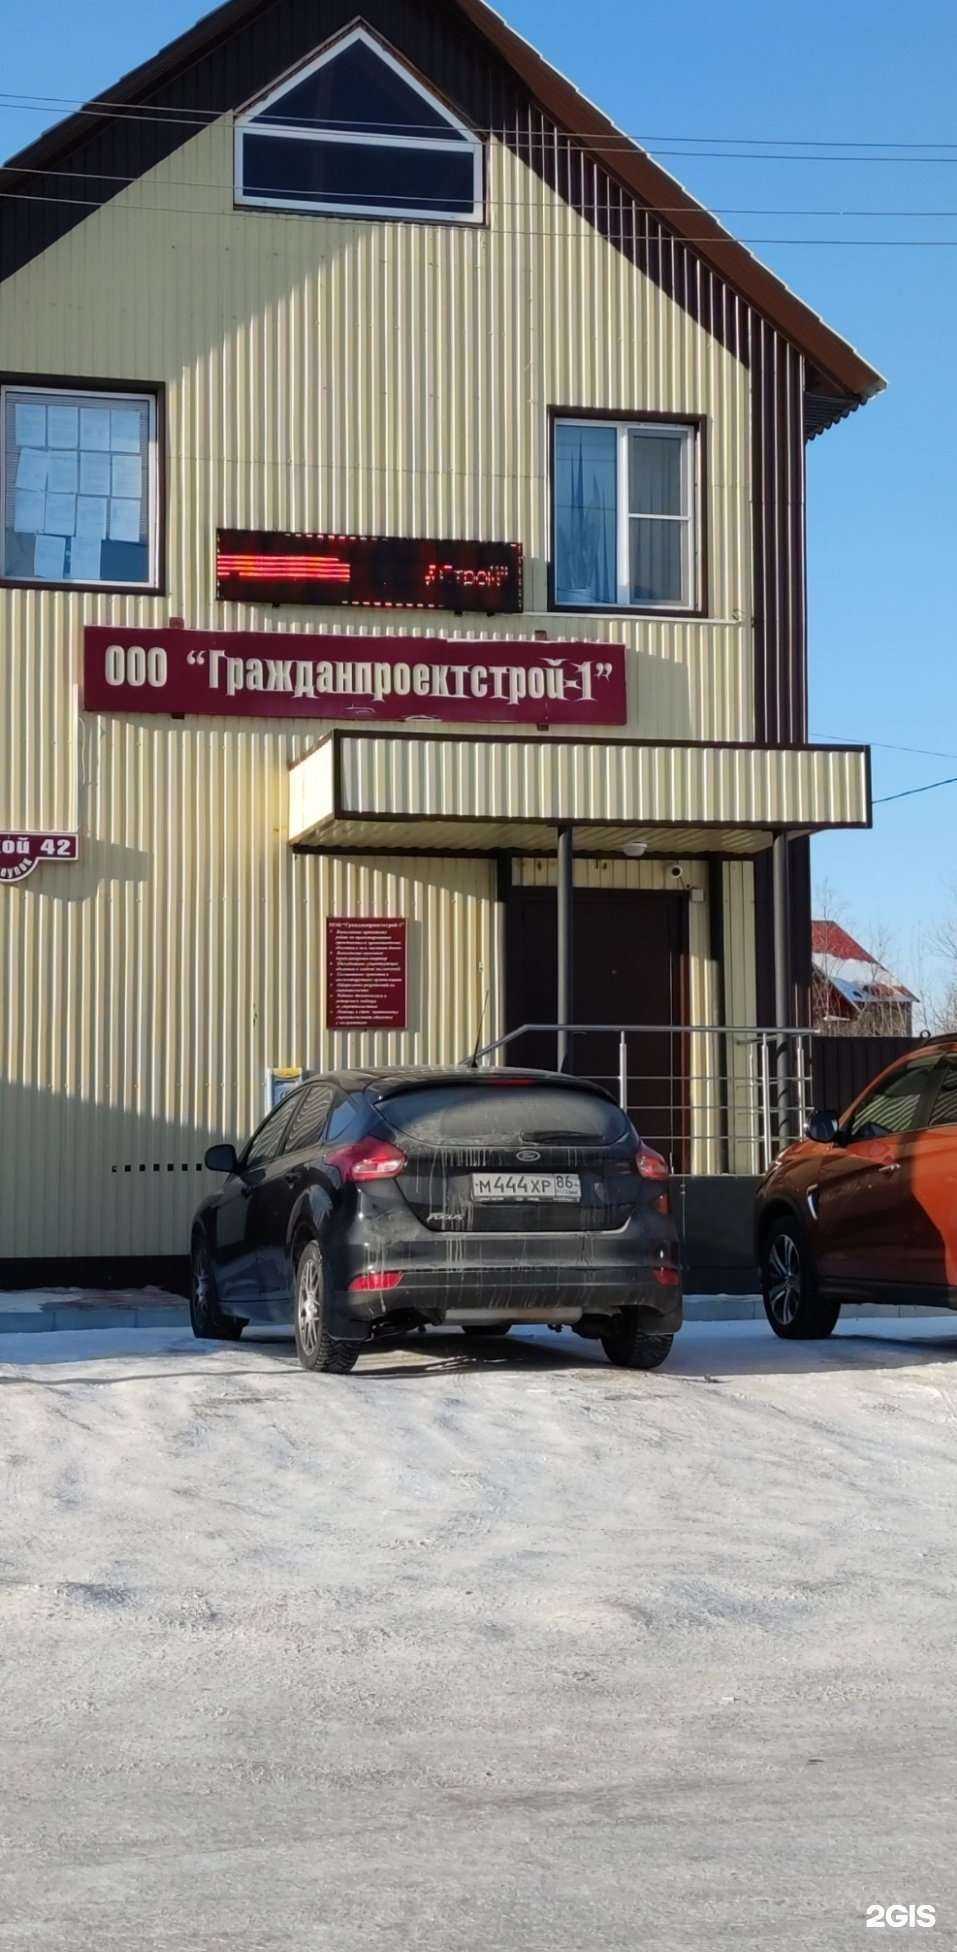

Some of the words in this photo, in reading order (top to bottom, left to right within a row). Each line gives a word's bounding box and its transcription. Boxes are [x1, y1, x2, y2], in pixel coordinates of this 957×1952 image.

[104, 644, 168, 688] ООО
[0, 837, 30, 854] ой
[40, 839, 71, 855] 42
[556, 1175, 574, 1188] 86
